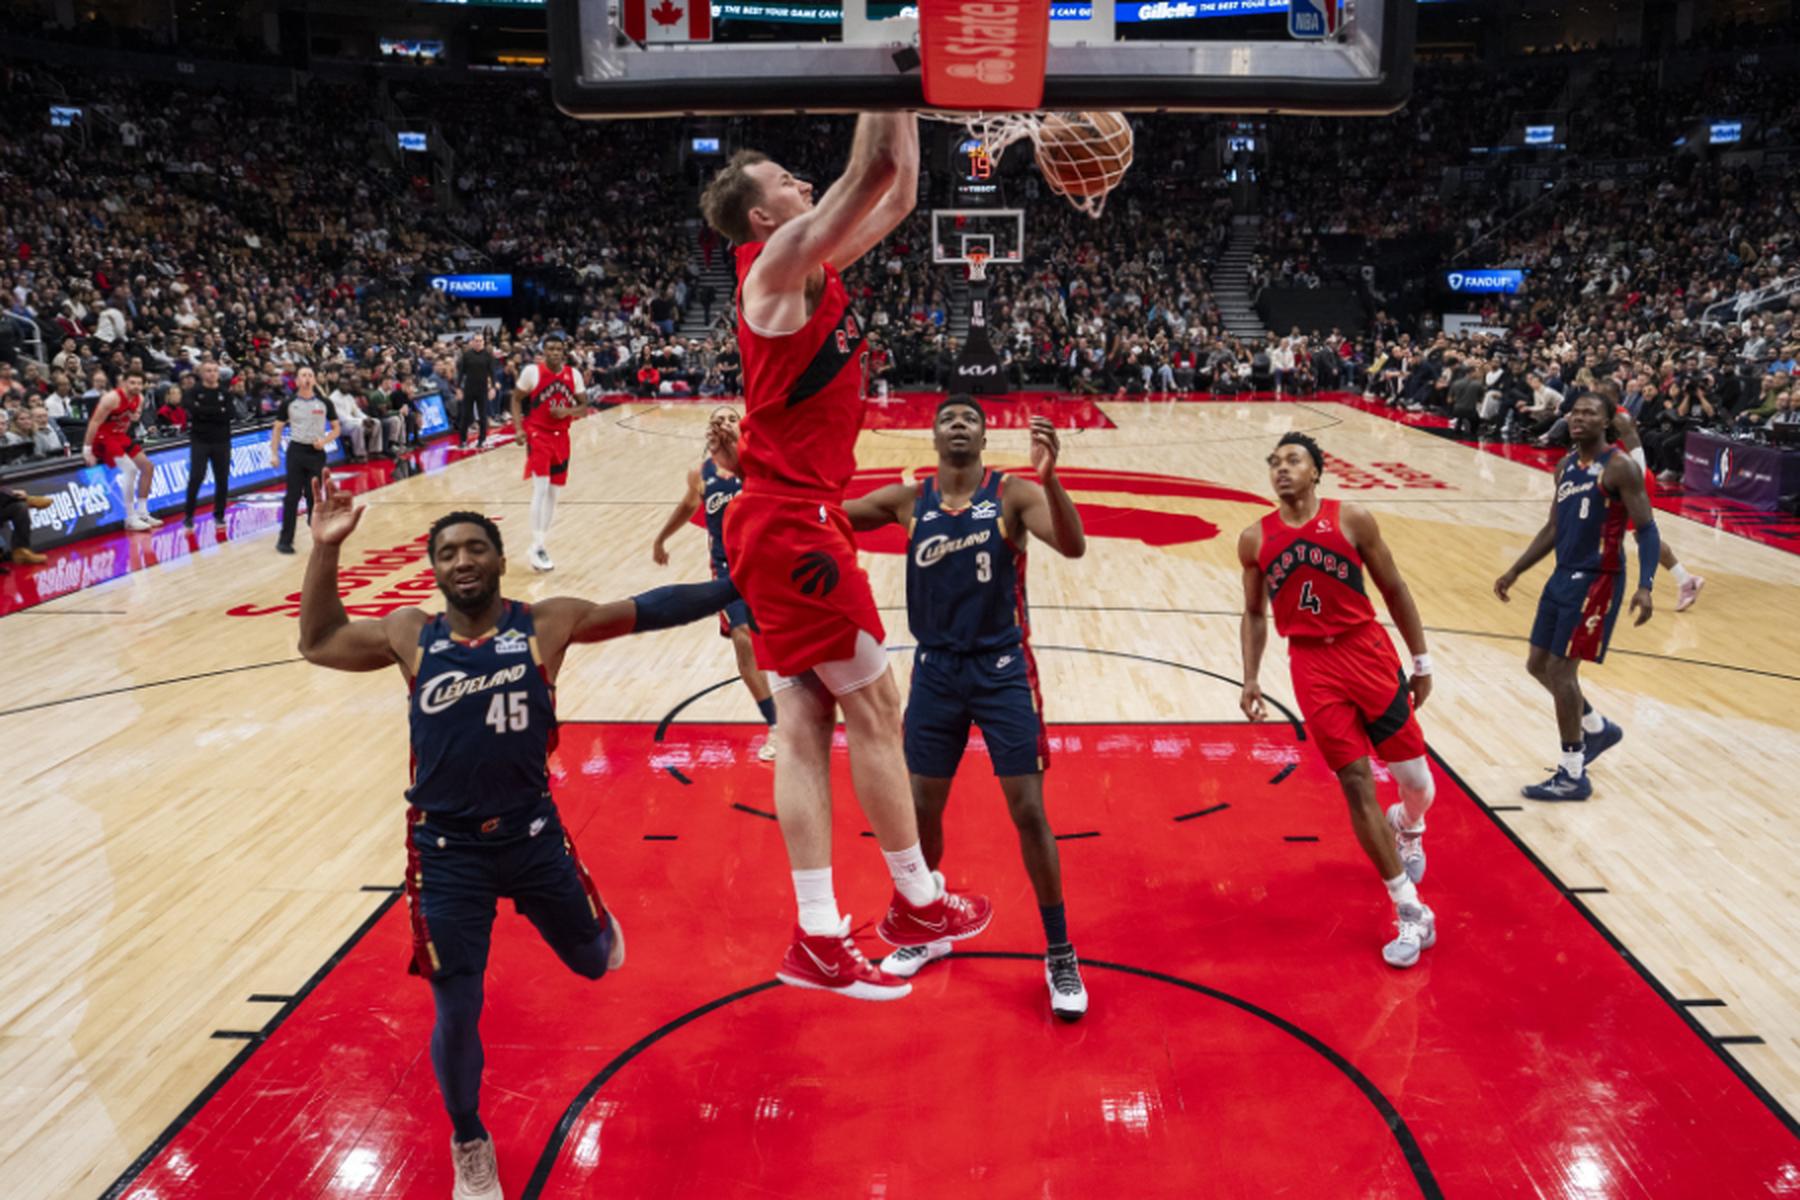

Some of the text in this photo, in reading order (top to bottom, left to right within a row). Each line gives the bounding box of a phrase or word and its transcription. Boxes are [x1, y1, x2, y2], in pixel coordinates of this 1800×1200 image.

[818, 9, 839, 19] CAN
[1057, 8, 1077, 17] CAN
[1138, 4, 1197, 21] Gillette
[1217, 2, 1237, 11] BEST
[1295, 12, 1320, 31] NBA
[449, 281, 498, 292] FANDUEL
[975, 550, 993, 584] 3
[1298, 580, 1321, 615] 4
[485, 690, 530, 734] 45
